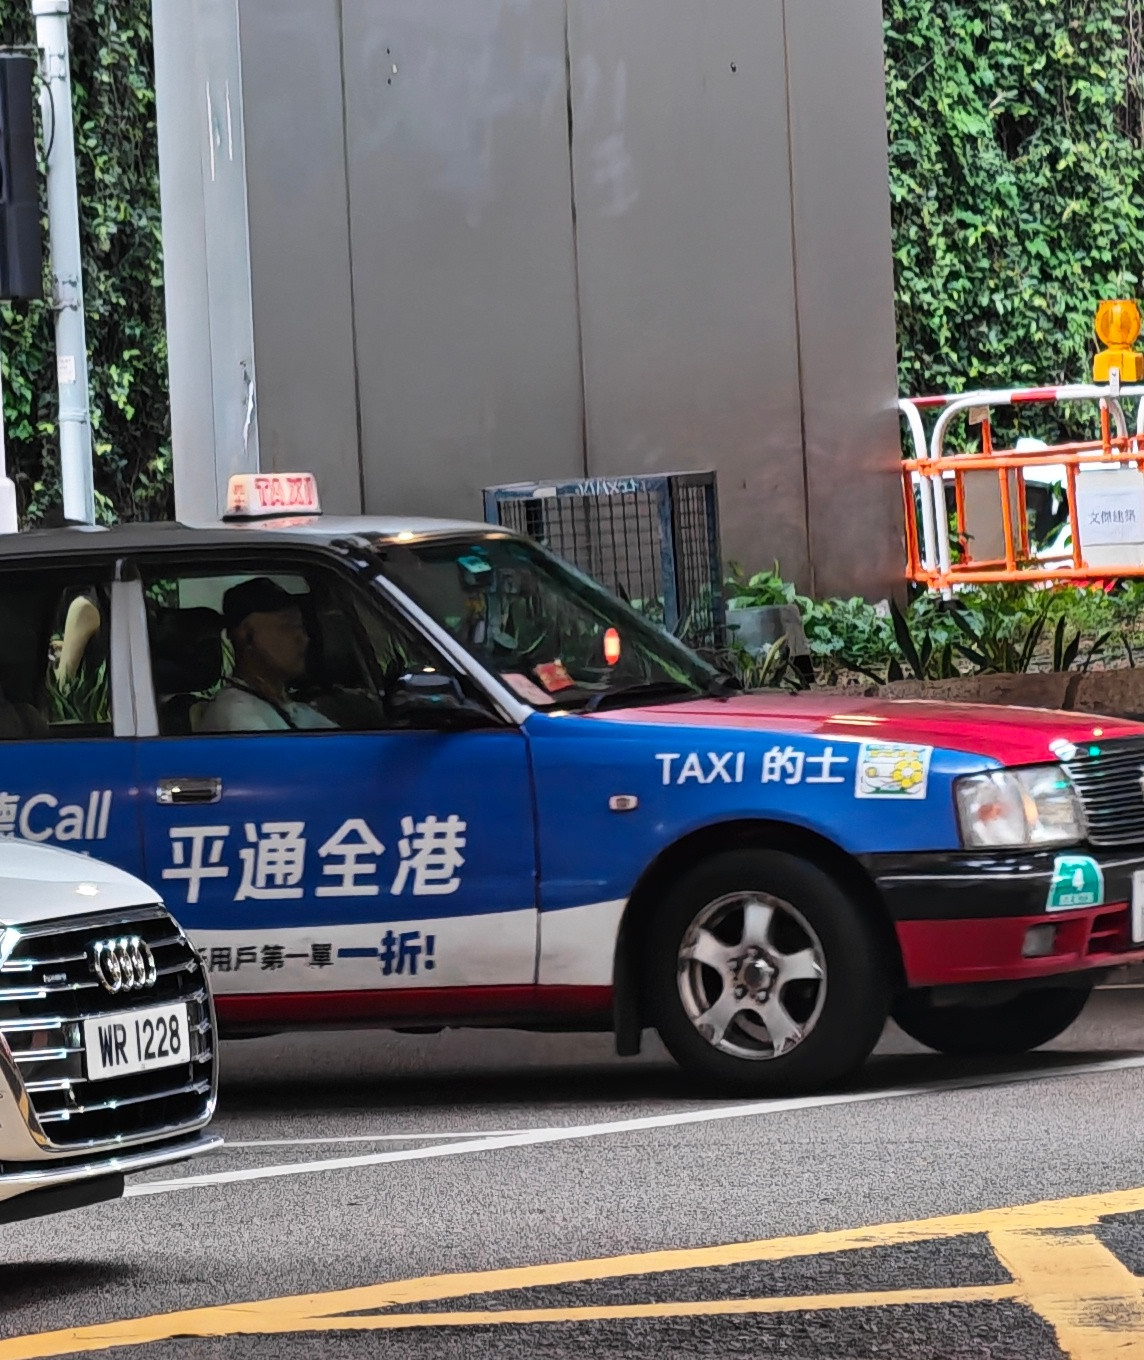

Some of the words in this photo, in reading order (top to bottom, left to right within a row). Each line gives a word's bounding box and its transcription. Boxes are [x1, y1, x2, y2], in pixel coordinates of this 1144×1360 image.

[254, 476, 313, 507] TAXI
[654, 751, 746, 785] TAXI
[761, 745, 850, 785] 的士
[161, 814, 468, 904] 平通全港
[97, 1023, 129, 1069] WR
[135, 1014, 181, 1063] 1228
